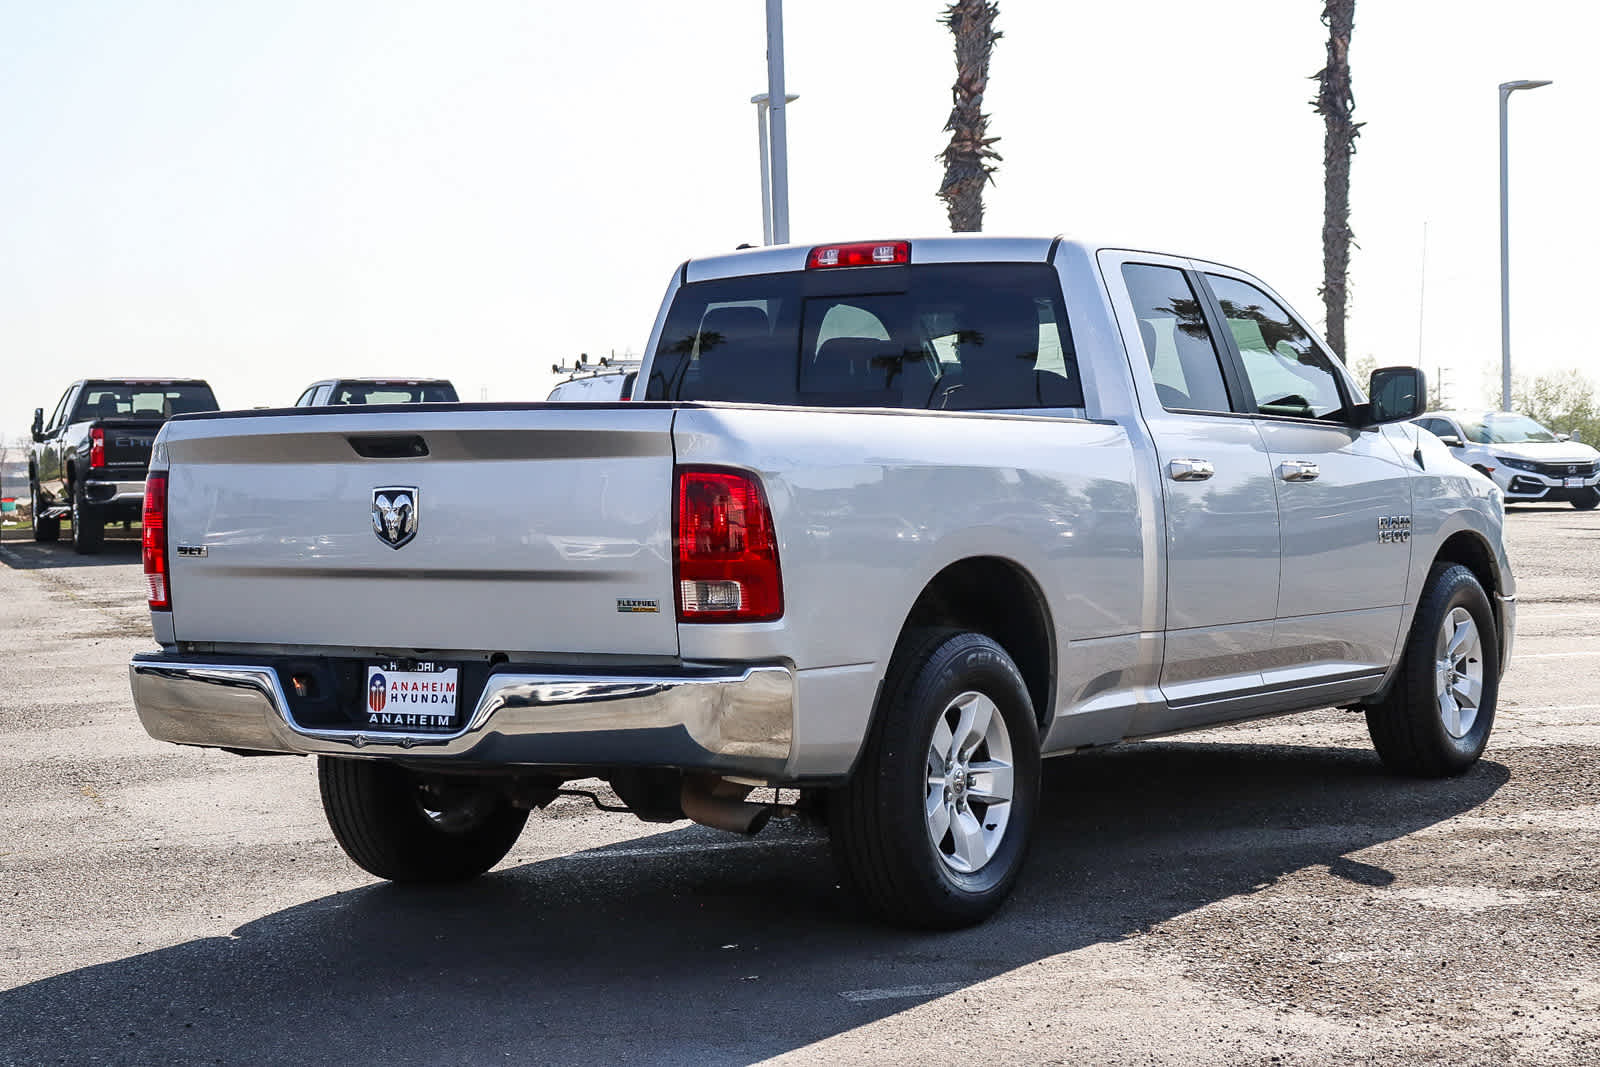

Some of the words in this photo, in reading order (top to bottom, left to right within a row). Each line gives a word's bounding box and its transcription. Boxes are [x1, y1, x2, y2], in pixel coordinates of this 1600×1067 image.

[1378, 516, 1410, 529] RAM
[1379, 529, 1410, 543] 1500
[616, 599, 657, 607] FLEXFUEL
[391, 682, 455, 692] ANAHEIM
[391, 693, 454, 704] HYUNDAI
[369, 713, 449, 726] ANAHEIM
